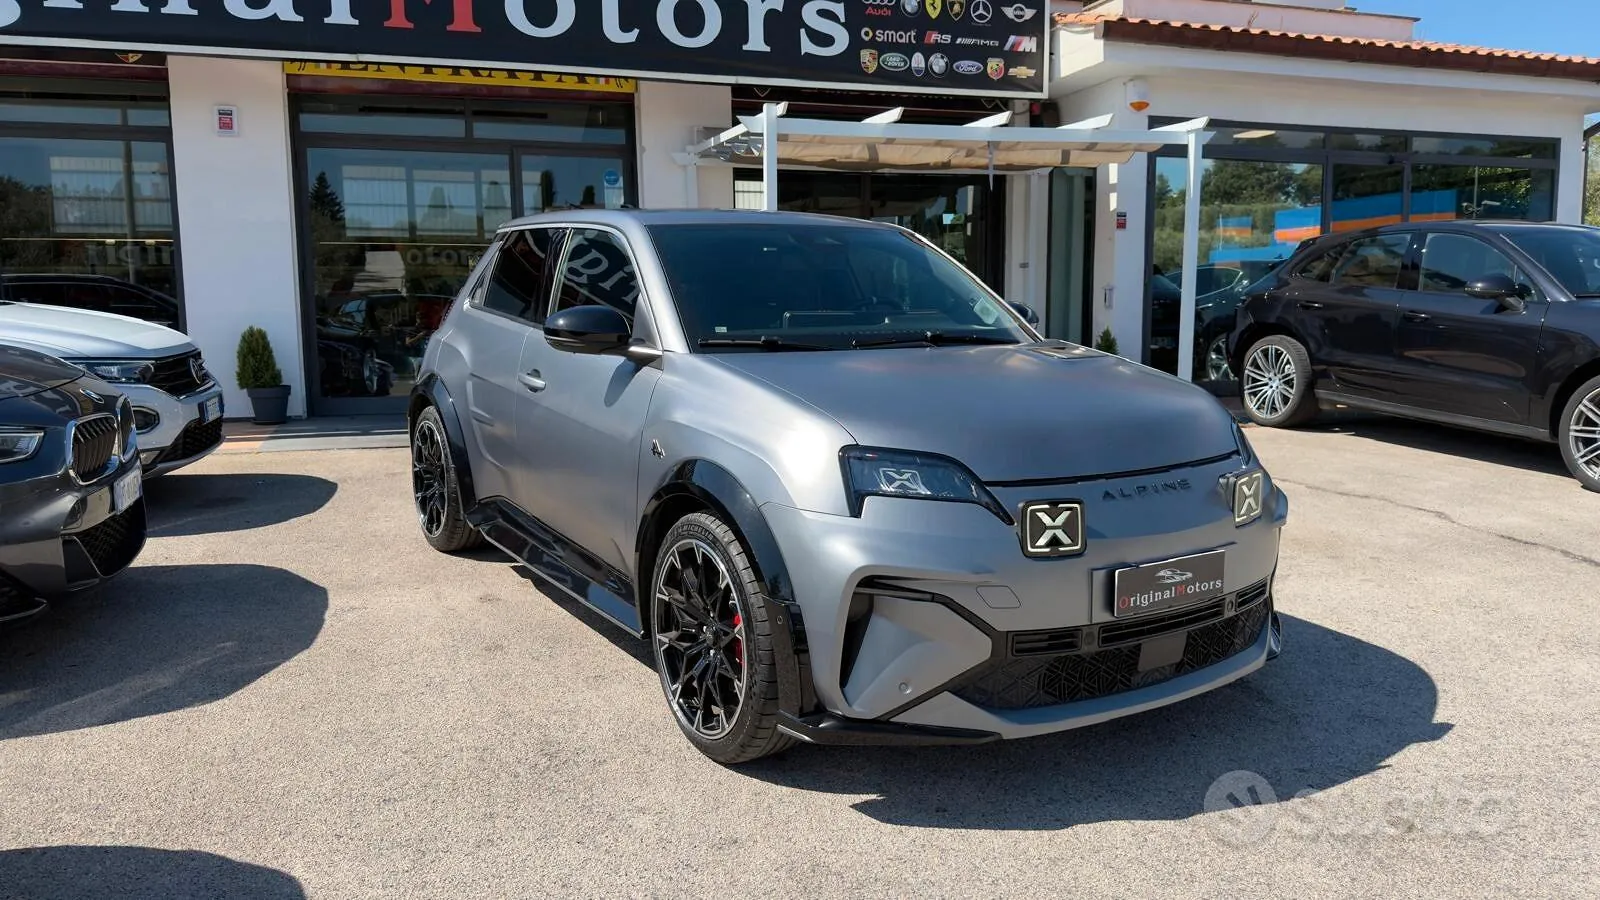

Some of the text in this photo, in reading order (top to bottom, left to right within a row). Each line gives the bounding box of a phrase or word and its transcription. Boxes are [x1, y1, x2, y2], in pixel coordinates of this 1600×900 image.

[865, 6, 892, 16] Audi
[875, 29, 917, 44] smart
[931, 34, 952, 44] RS
[959, 63, 977, 72] Ford
[1101, 477, 1192, 501] ALPINE
[1119, 578, 1223, 609] OriginalMotors
